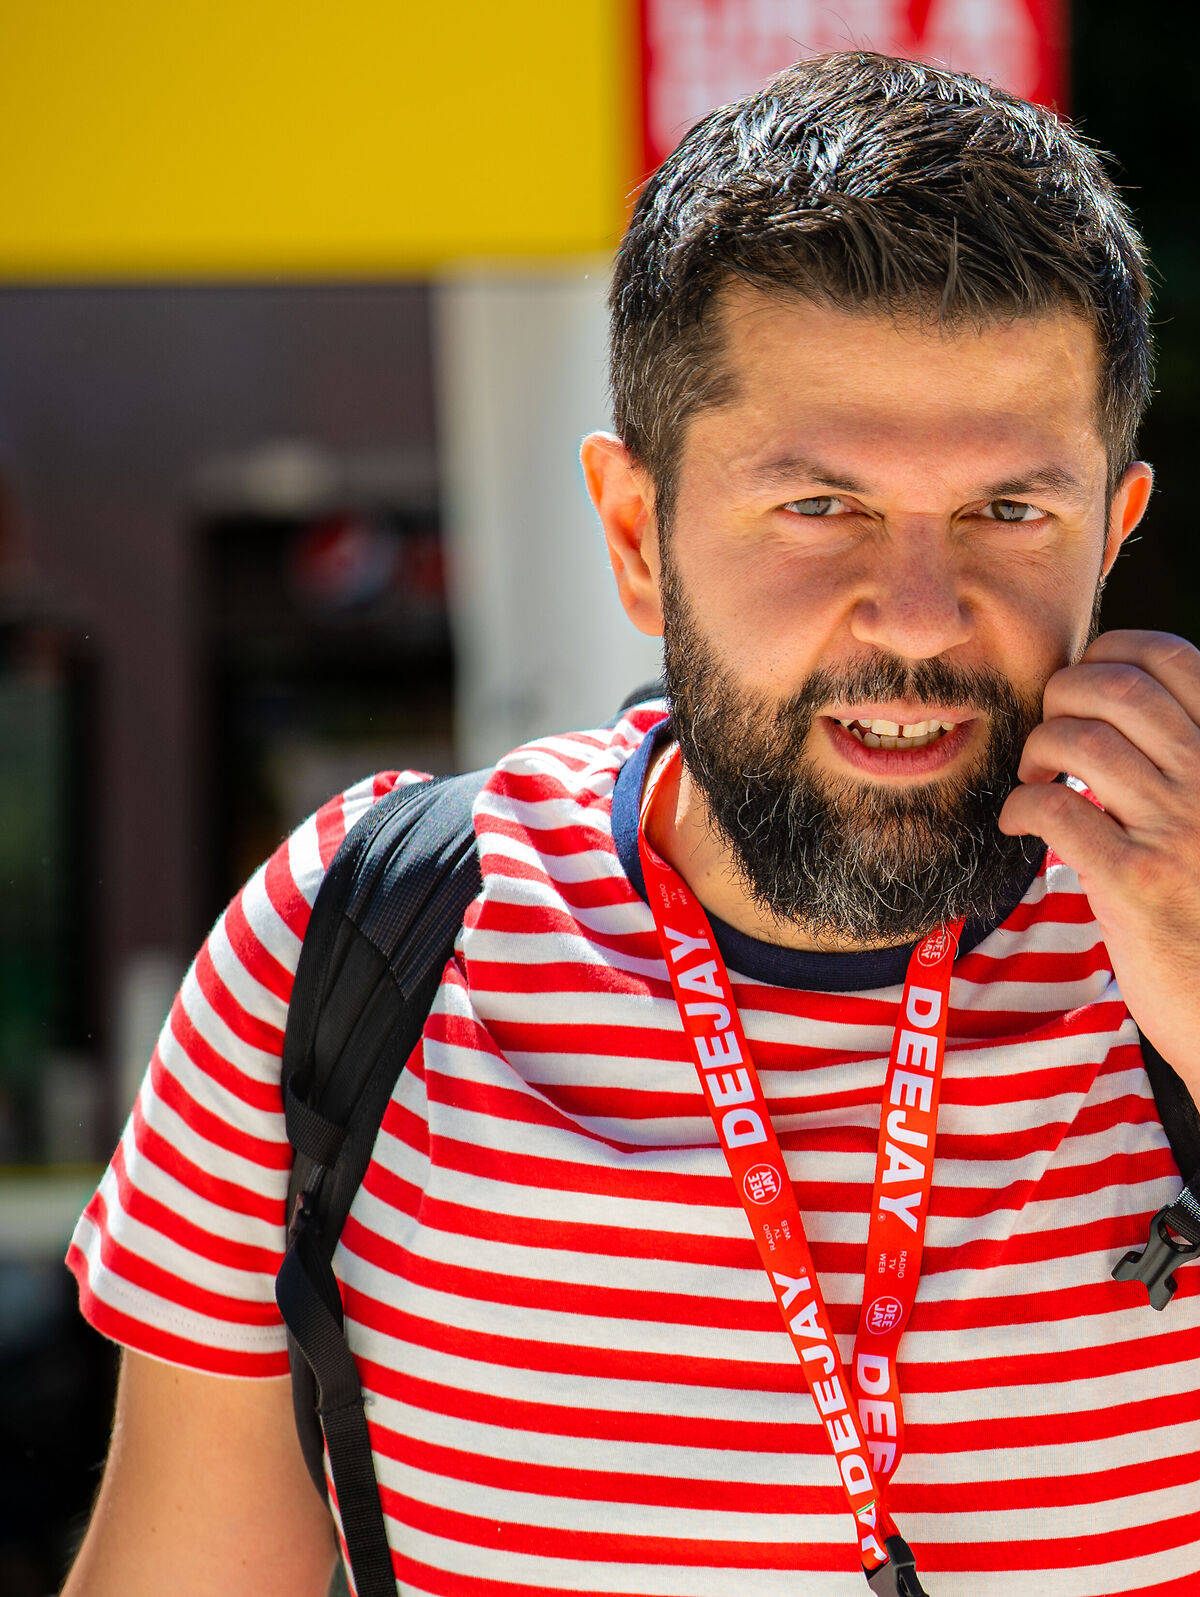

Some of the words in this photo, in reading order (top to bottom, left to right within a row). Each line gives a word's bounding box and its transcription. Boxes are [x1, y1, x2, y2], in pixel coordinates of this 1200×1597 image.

[663, 926, 768, 1149] DEEJAY
[878, 985, 942, 1232] DEEJAY
[748, 1173, 766, 1200] DEE
[759, 1170, 777, 1193] JAY
[763, 1223, 777, 1251] RADIO
[773, 1228, 782, 1240] TV
[780, 1219, 792, 1241] WEB
[878, 1253, 887, 1274] WEB
[888, 1259, 897, 1270] TV
[897, 1250, 908, 1279] RADIO
[871, 1303, 886, 1328] JAY
[882, 1303, 899, 1328] DEE
[772, 1271, 873, 1497] DEEJAY
